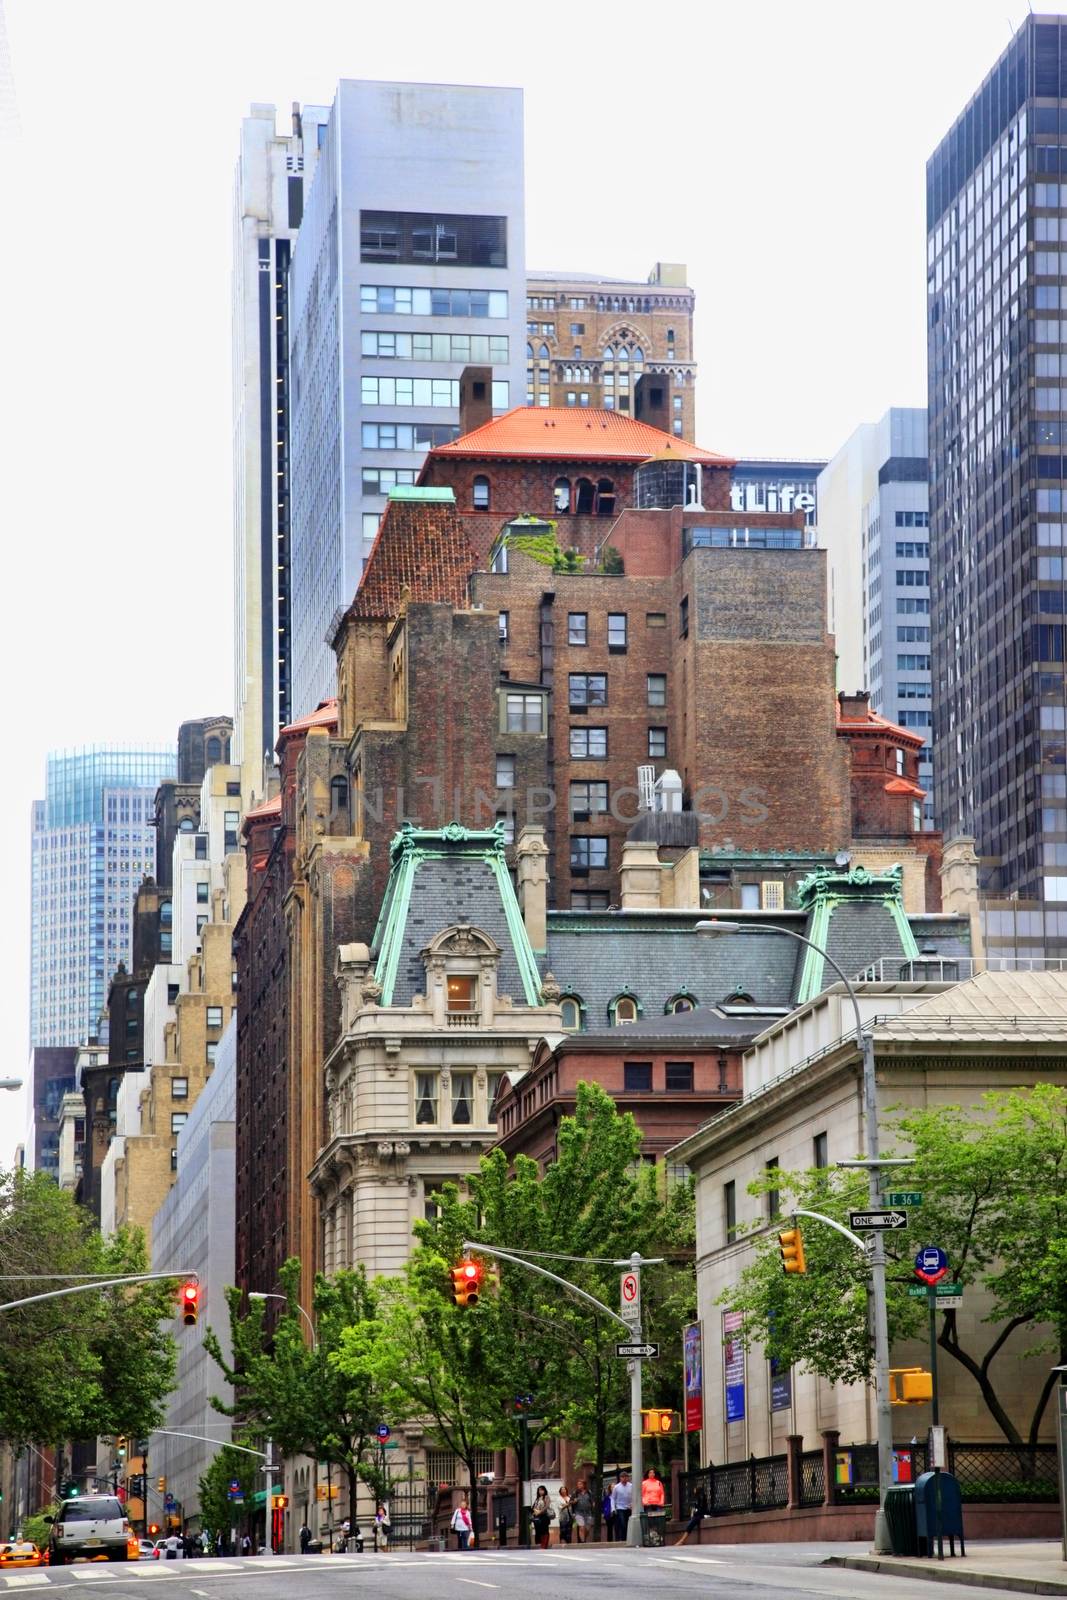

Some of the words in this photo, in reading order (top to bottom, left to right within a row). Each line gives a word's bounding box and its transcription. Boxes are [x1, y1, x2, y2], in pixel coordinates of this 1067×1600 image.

[893, 1196, 897, 1205] E
[901, 1194, 912, 1205] 36
[855, 1217, 873, 1225] ONE
[883, 1216, 900, 1224] WAY
